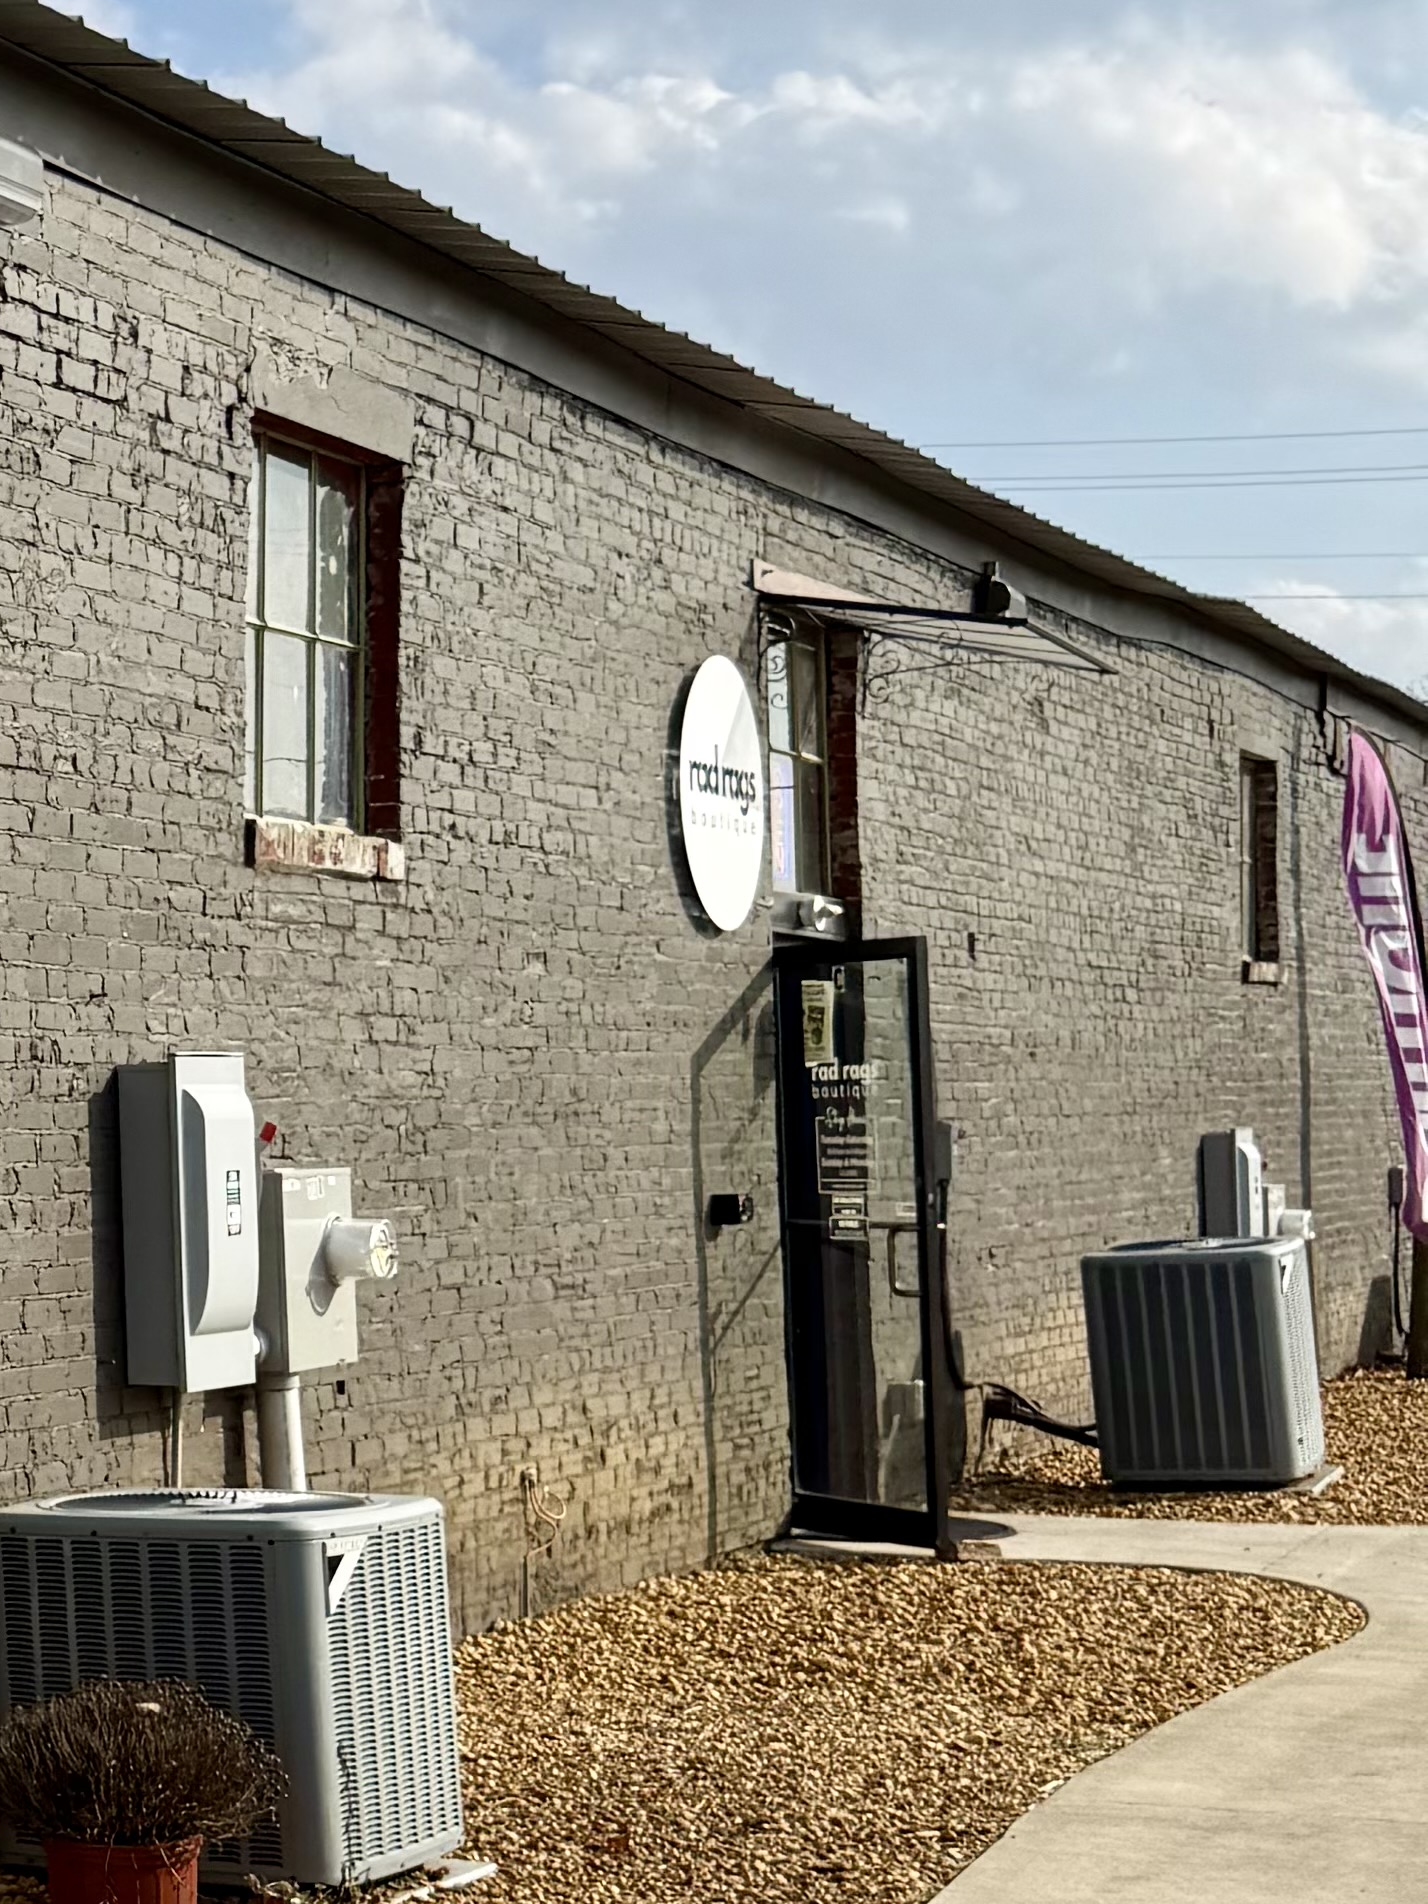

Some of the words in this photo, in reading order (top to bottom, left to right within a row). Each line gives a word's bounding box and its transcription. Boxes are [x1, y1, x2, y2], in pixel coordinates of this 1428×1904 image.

[689, 744, 719, 796] rad
[722, 765, 756, 816] rags
[691, 808, 756, 836] boutique
[811, 1057, 839, 1082] rad
[842, 1063, 879, 1085] rags
